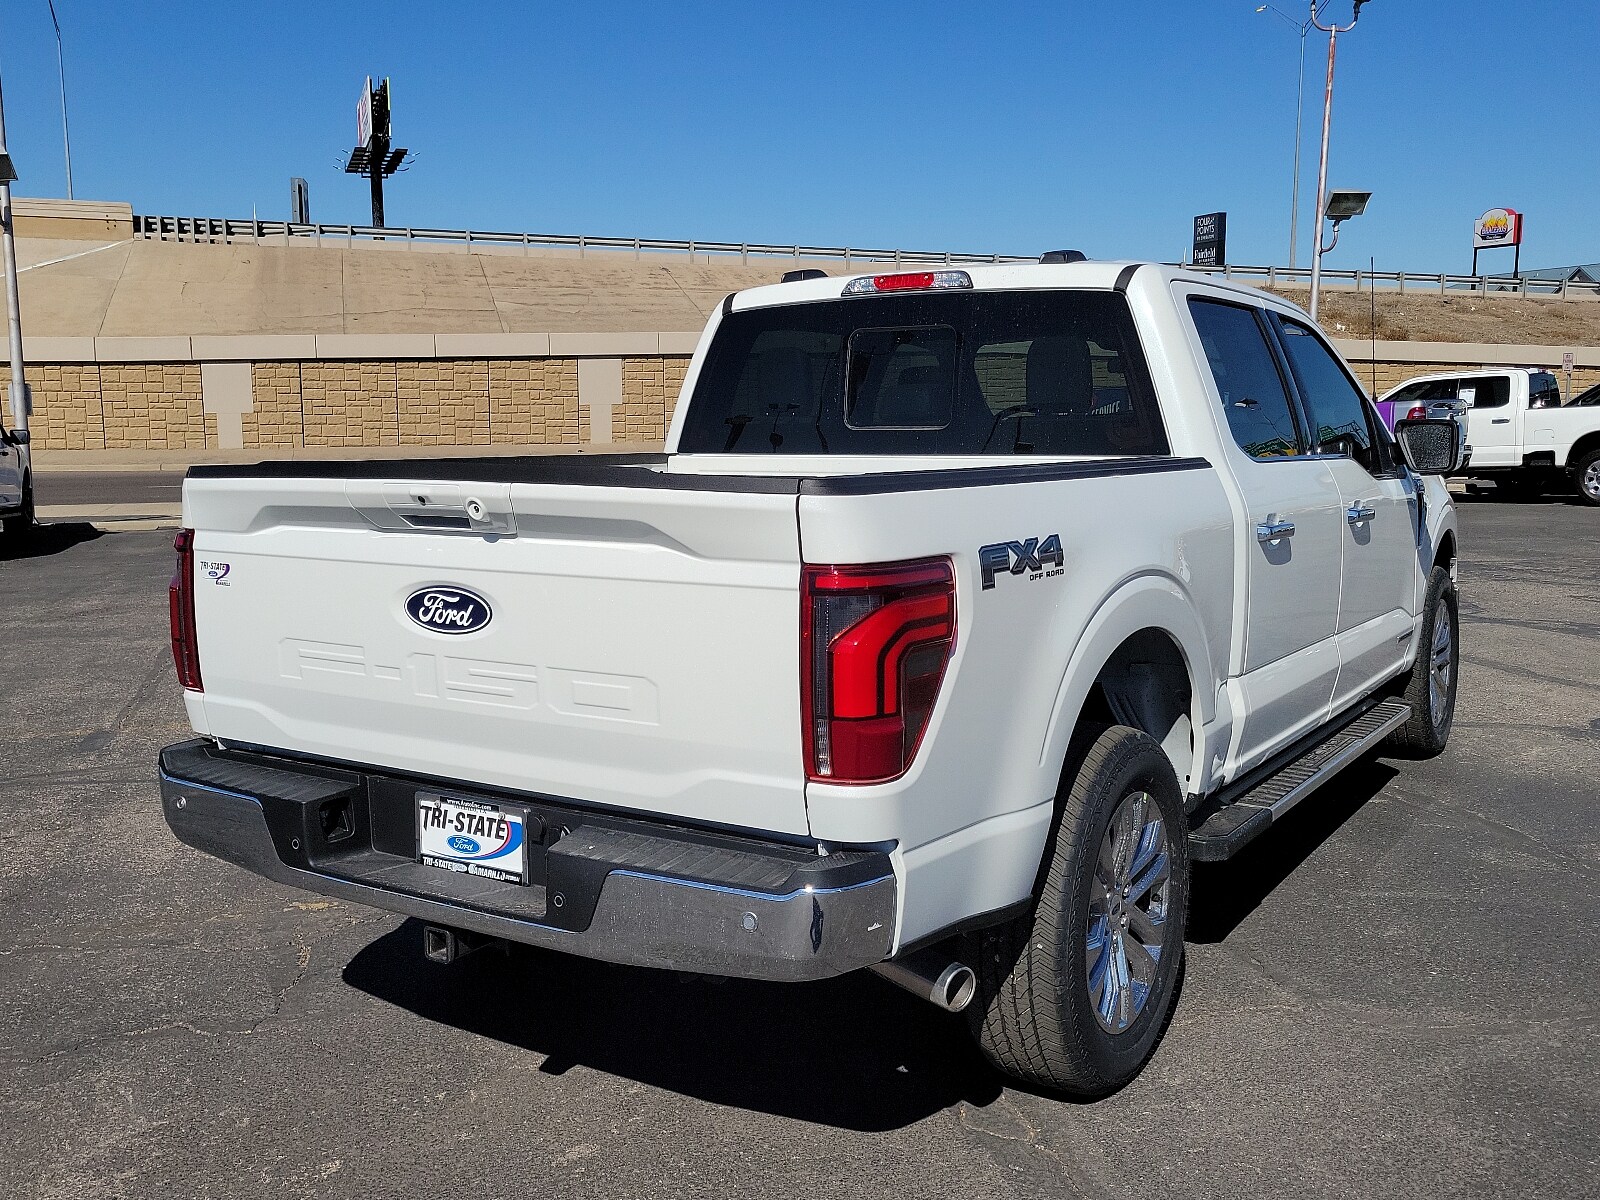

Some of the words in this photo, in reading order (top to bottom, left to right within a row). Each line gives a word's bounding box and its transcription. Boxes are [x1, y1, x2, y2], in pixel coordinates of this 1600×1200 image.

[1197, 217, 1210, 227] FOUR
[1196, 224, 1215, 235] POINTS
[1194, 247, 1216, 260] Fairfield
[200, 561, 226, 571] TRI-STATE
[978, 533, 1065, 591] FX4
[1029, 572, 1044, 581] OFF
[1046, 568, 1065, 578] ROAD
[418, 593, 474, 627] Ford
[279, 637, 660, 727] F-150
[420, 805, 507, 841] TRI-STATE
[452, 837, 474, 852] Ford
[422, 856, 452, 870] TRI-STATE
